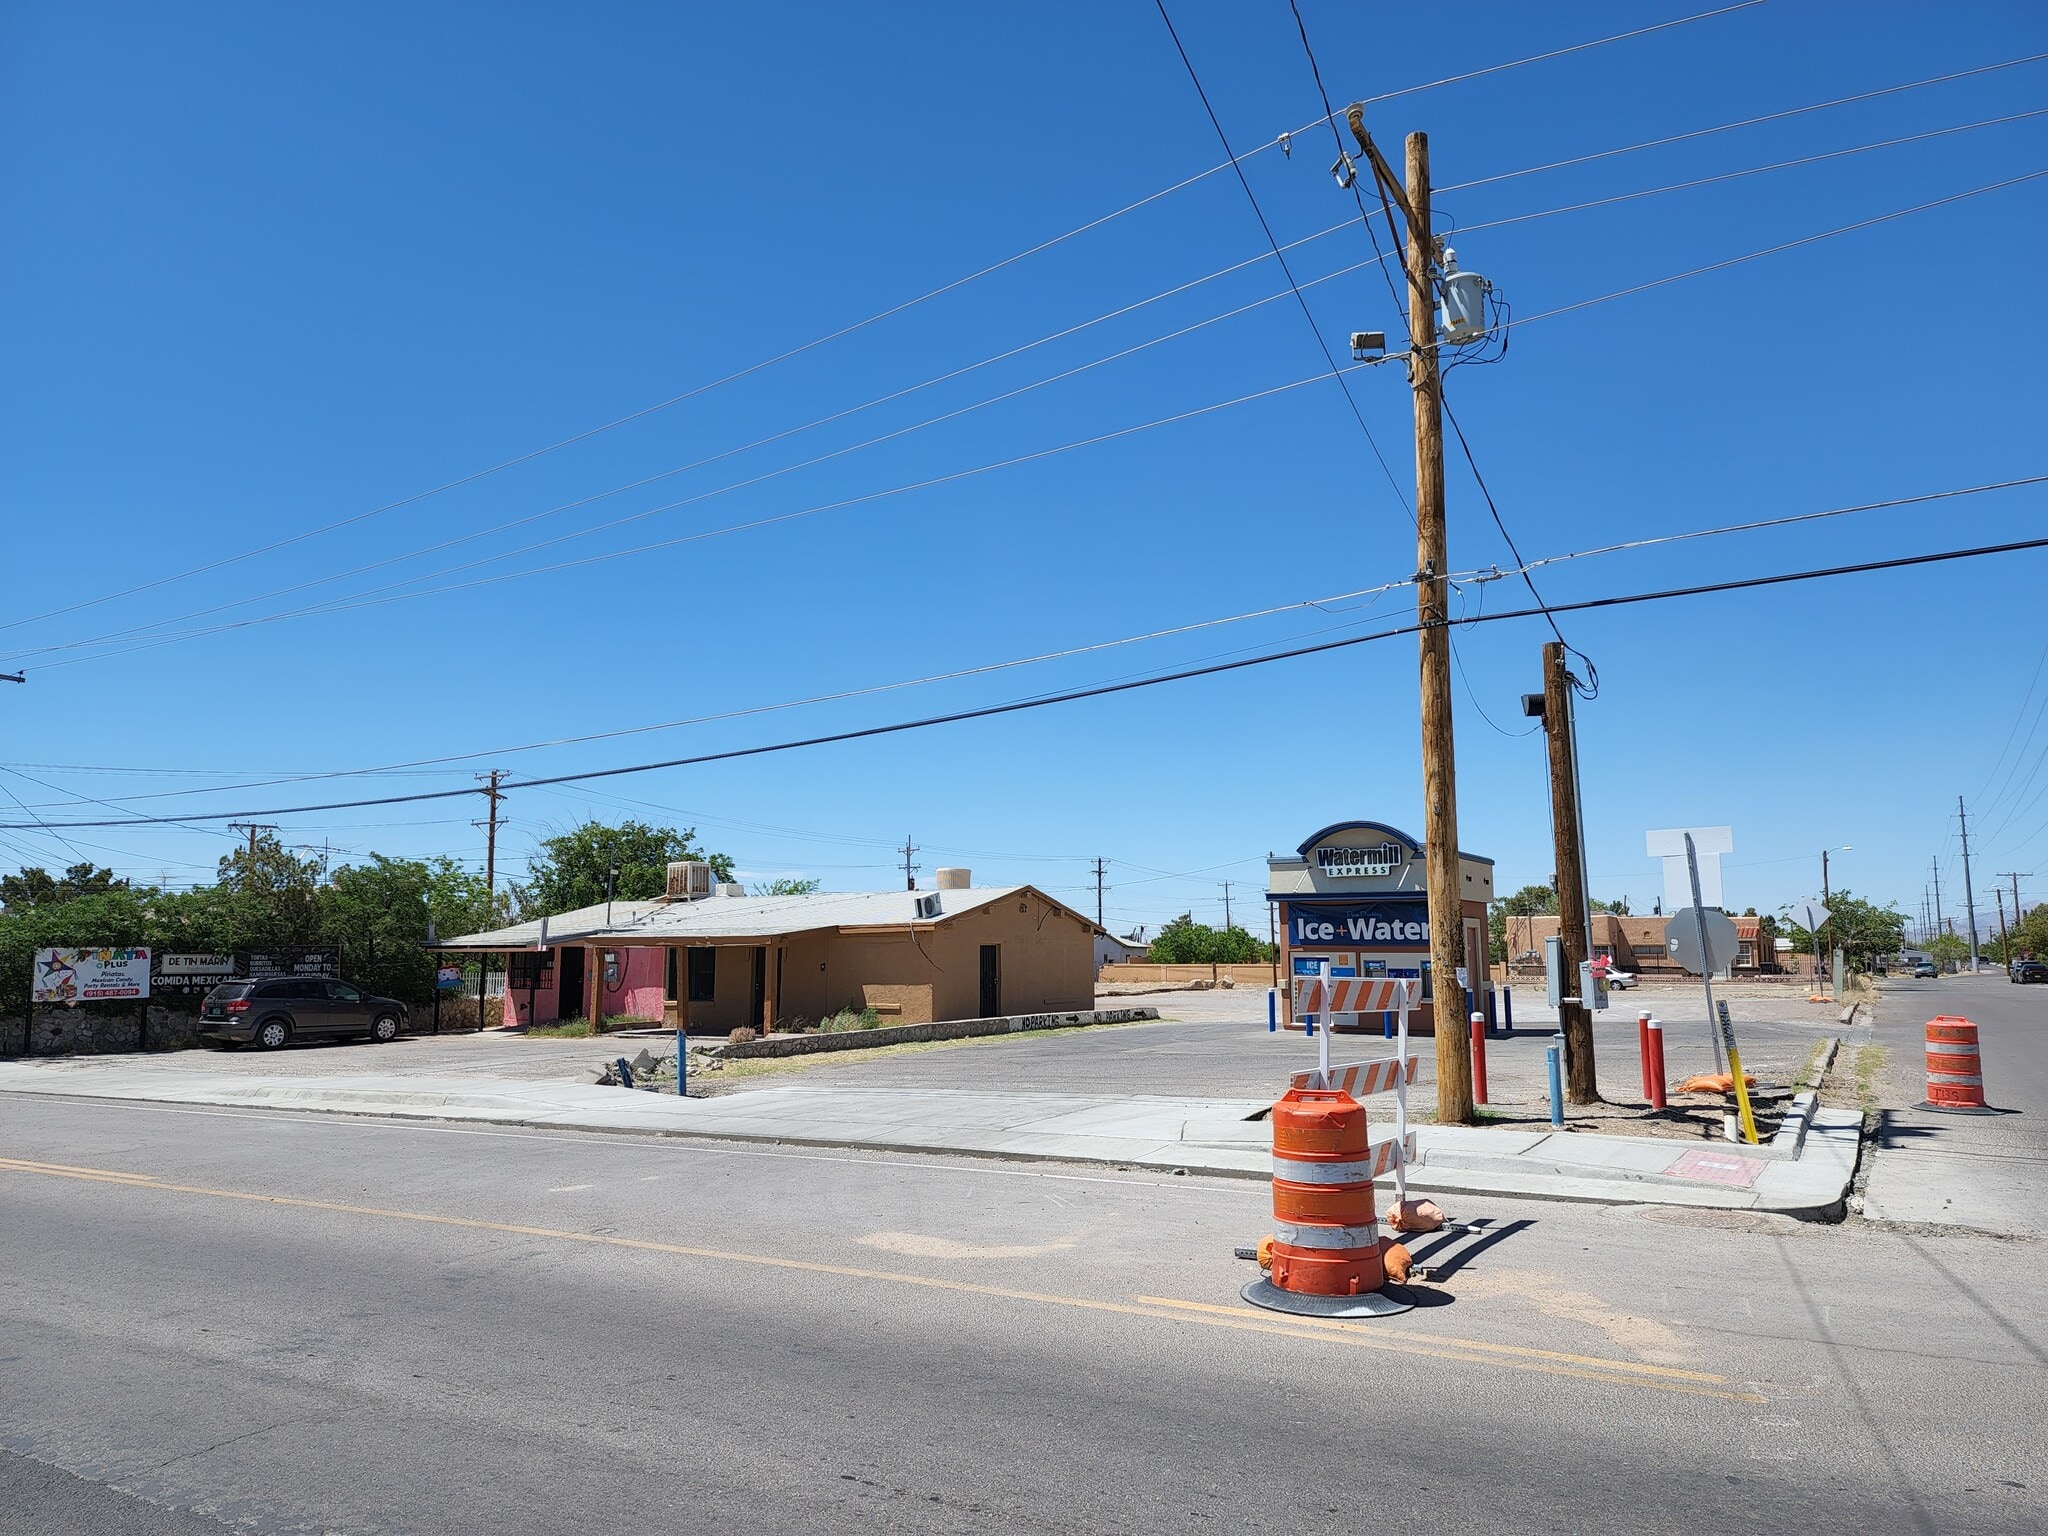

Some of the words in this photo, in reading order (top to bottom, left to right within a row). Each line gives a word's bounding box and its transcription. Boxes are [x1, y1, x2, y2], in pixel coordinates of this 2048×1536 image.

[1317, 843, 1400, 867] Watermill
[1328, 866, 1387, 876] EXPRESS
[1297, 918, 1335, 940] Ice
[1347, 917, 1430, 940] Water
[168, 957, 181, 966] DE
[184, 957, 197, 966] TIN
[304, 954, 322, 962] OPEN
[104, 960, 128, 969] PLUS
[294, 963, 321, 972] MONDAY
[323, 963, 331, 971] TO
[1306, 961, 1318, 969] ICE
[151, 976, 190, 985] COMIDA
[1105, 1009, 1130, 1022] PARKING
